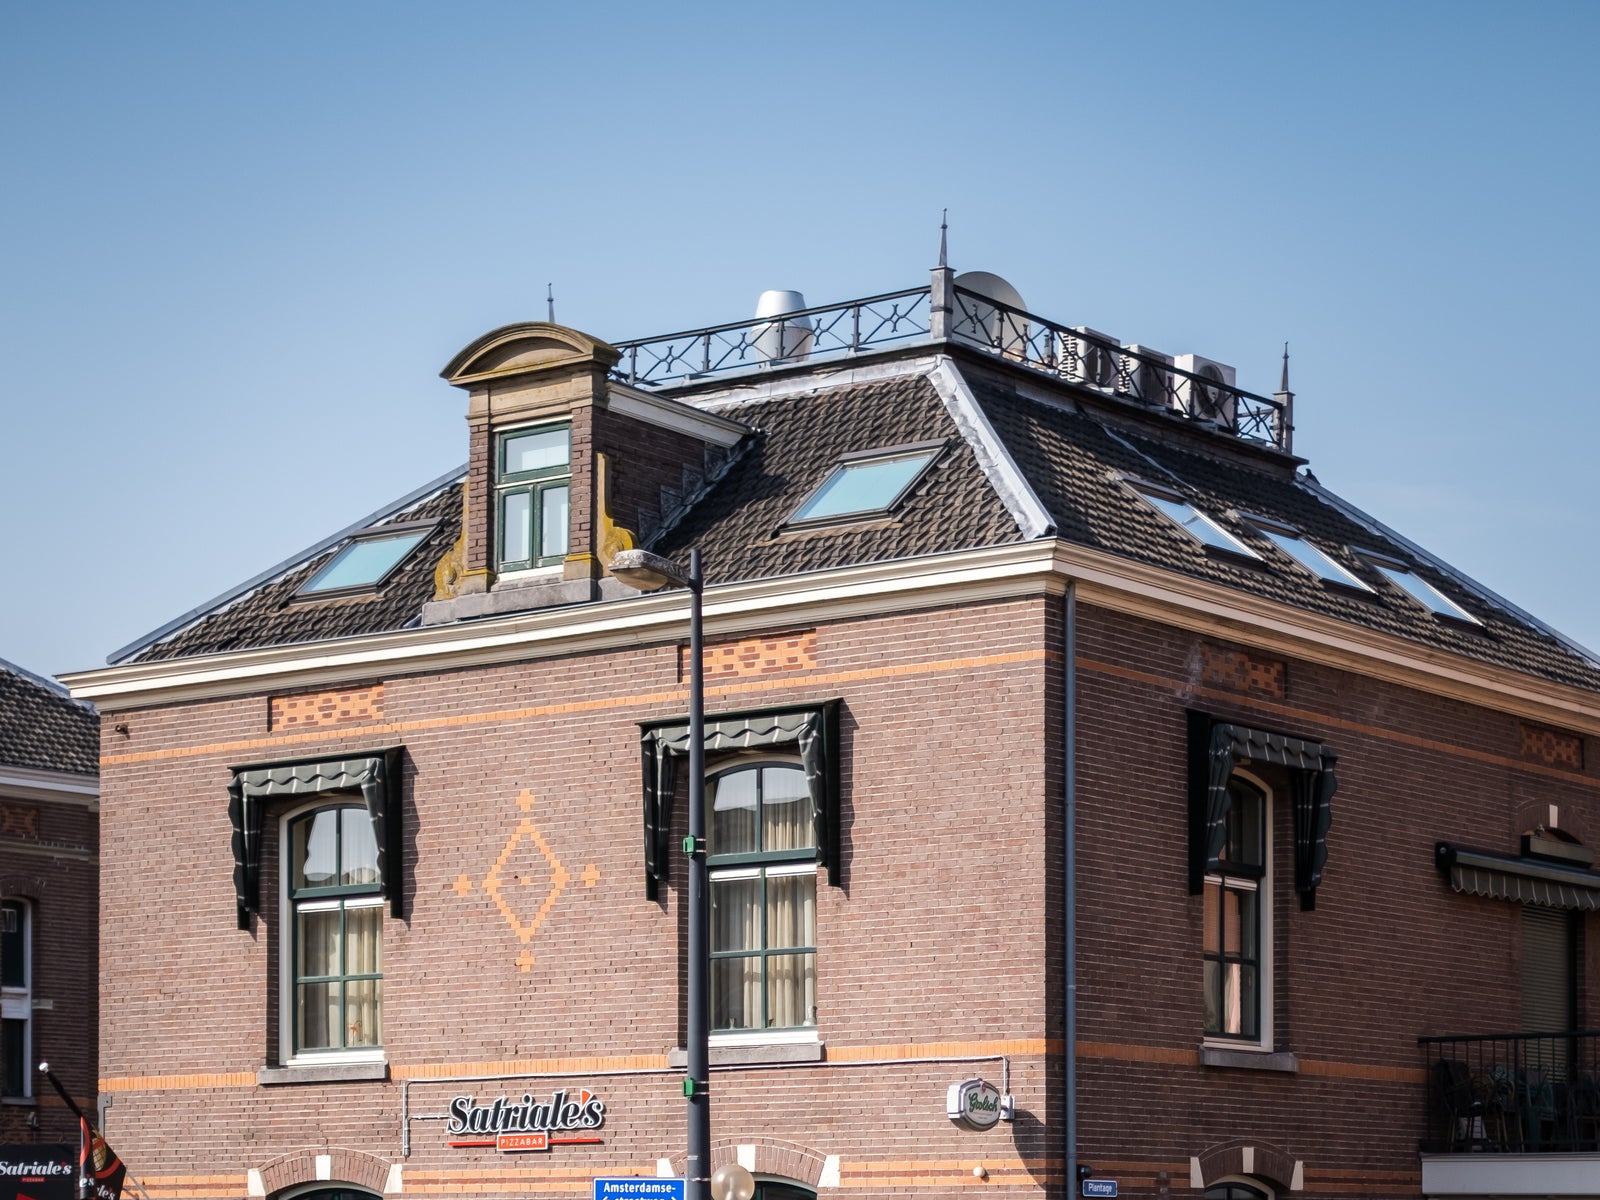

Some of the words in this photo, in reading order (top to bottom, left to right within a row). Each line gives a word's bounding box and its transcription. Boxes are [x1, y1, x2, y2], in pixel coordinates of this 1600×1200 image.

[968, 1092, 998, 1113] Grolsch
[448, 1089, 604, 1134] Satriale's
[500, 1136, 543, 1146] PIZZABAR
[0, 1160, 72, 1176] Satriale's
[603, 1182, 676, 1193] Amsterdamse-
[1088, 1182, 1113, 1194] Plantage
